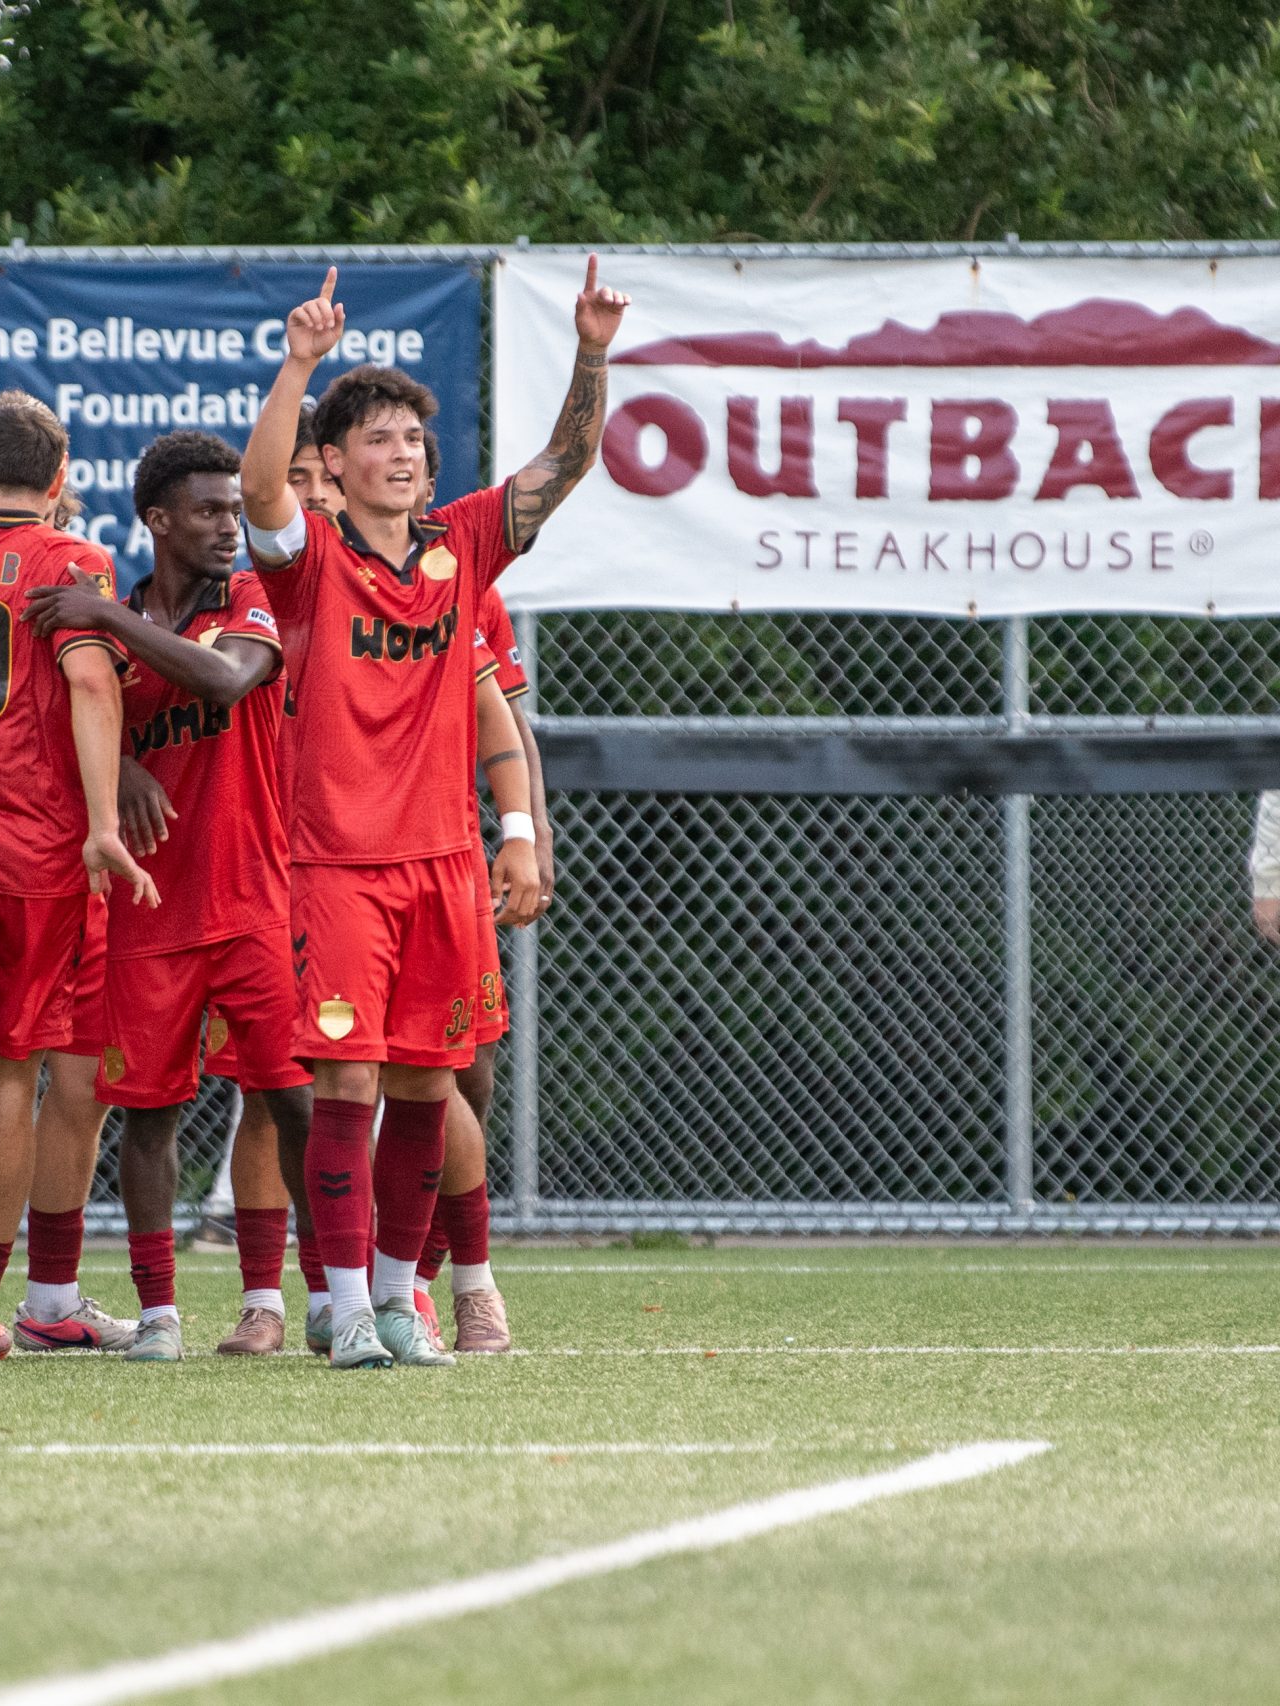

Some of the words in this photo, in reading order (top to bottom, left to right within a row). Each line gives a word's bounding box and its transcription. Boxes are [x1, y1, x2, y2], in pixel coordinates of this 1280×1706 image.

[47, 316, 244, 361] Bellevue
[602, 393, 1280, 501] OUTBAC
[445, 996, 475, 1038] 34
